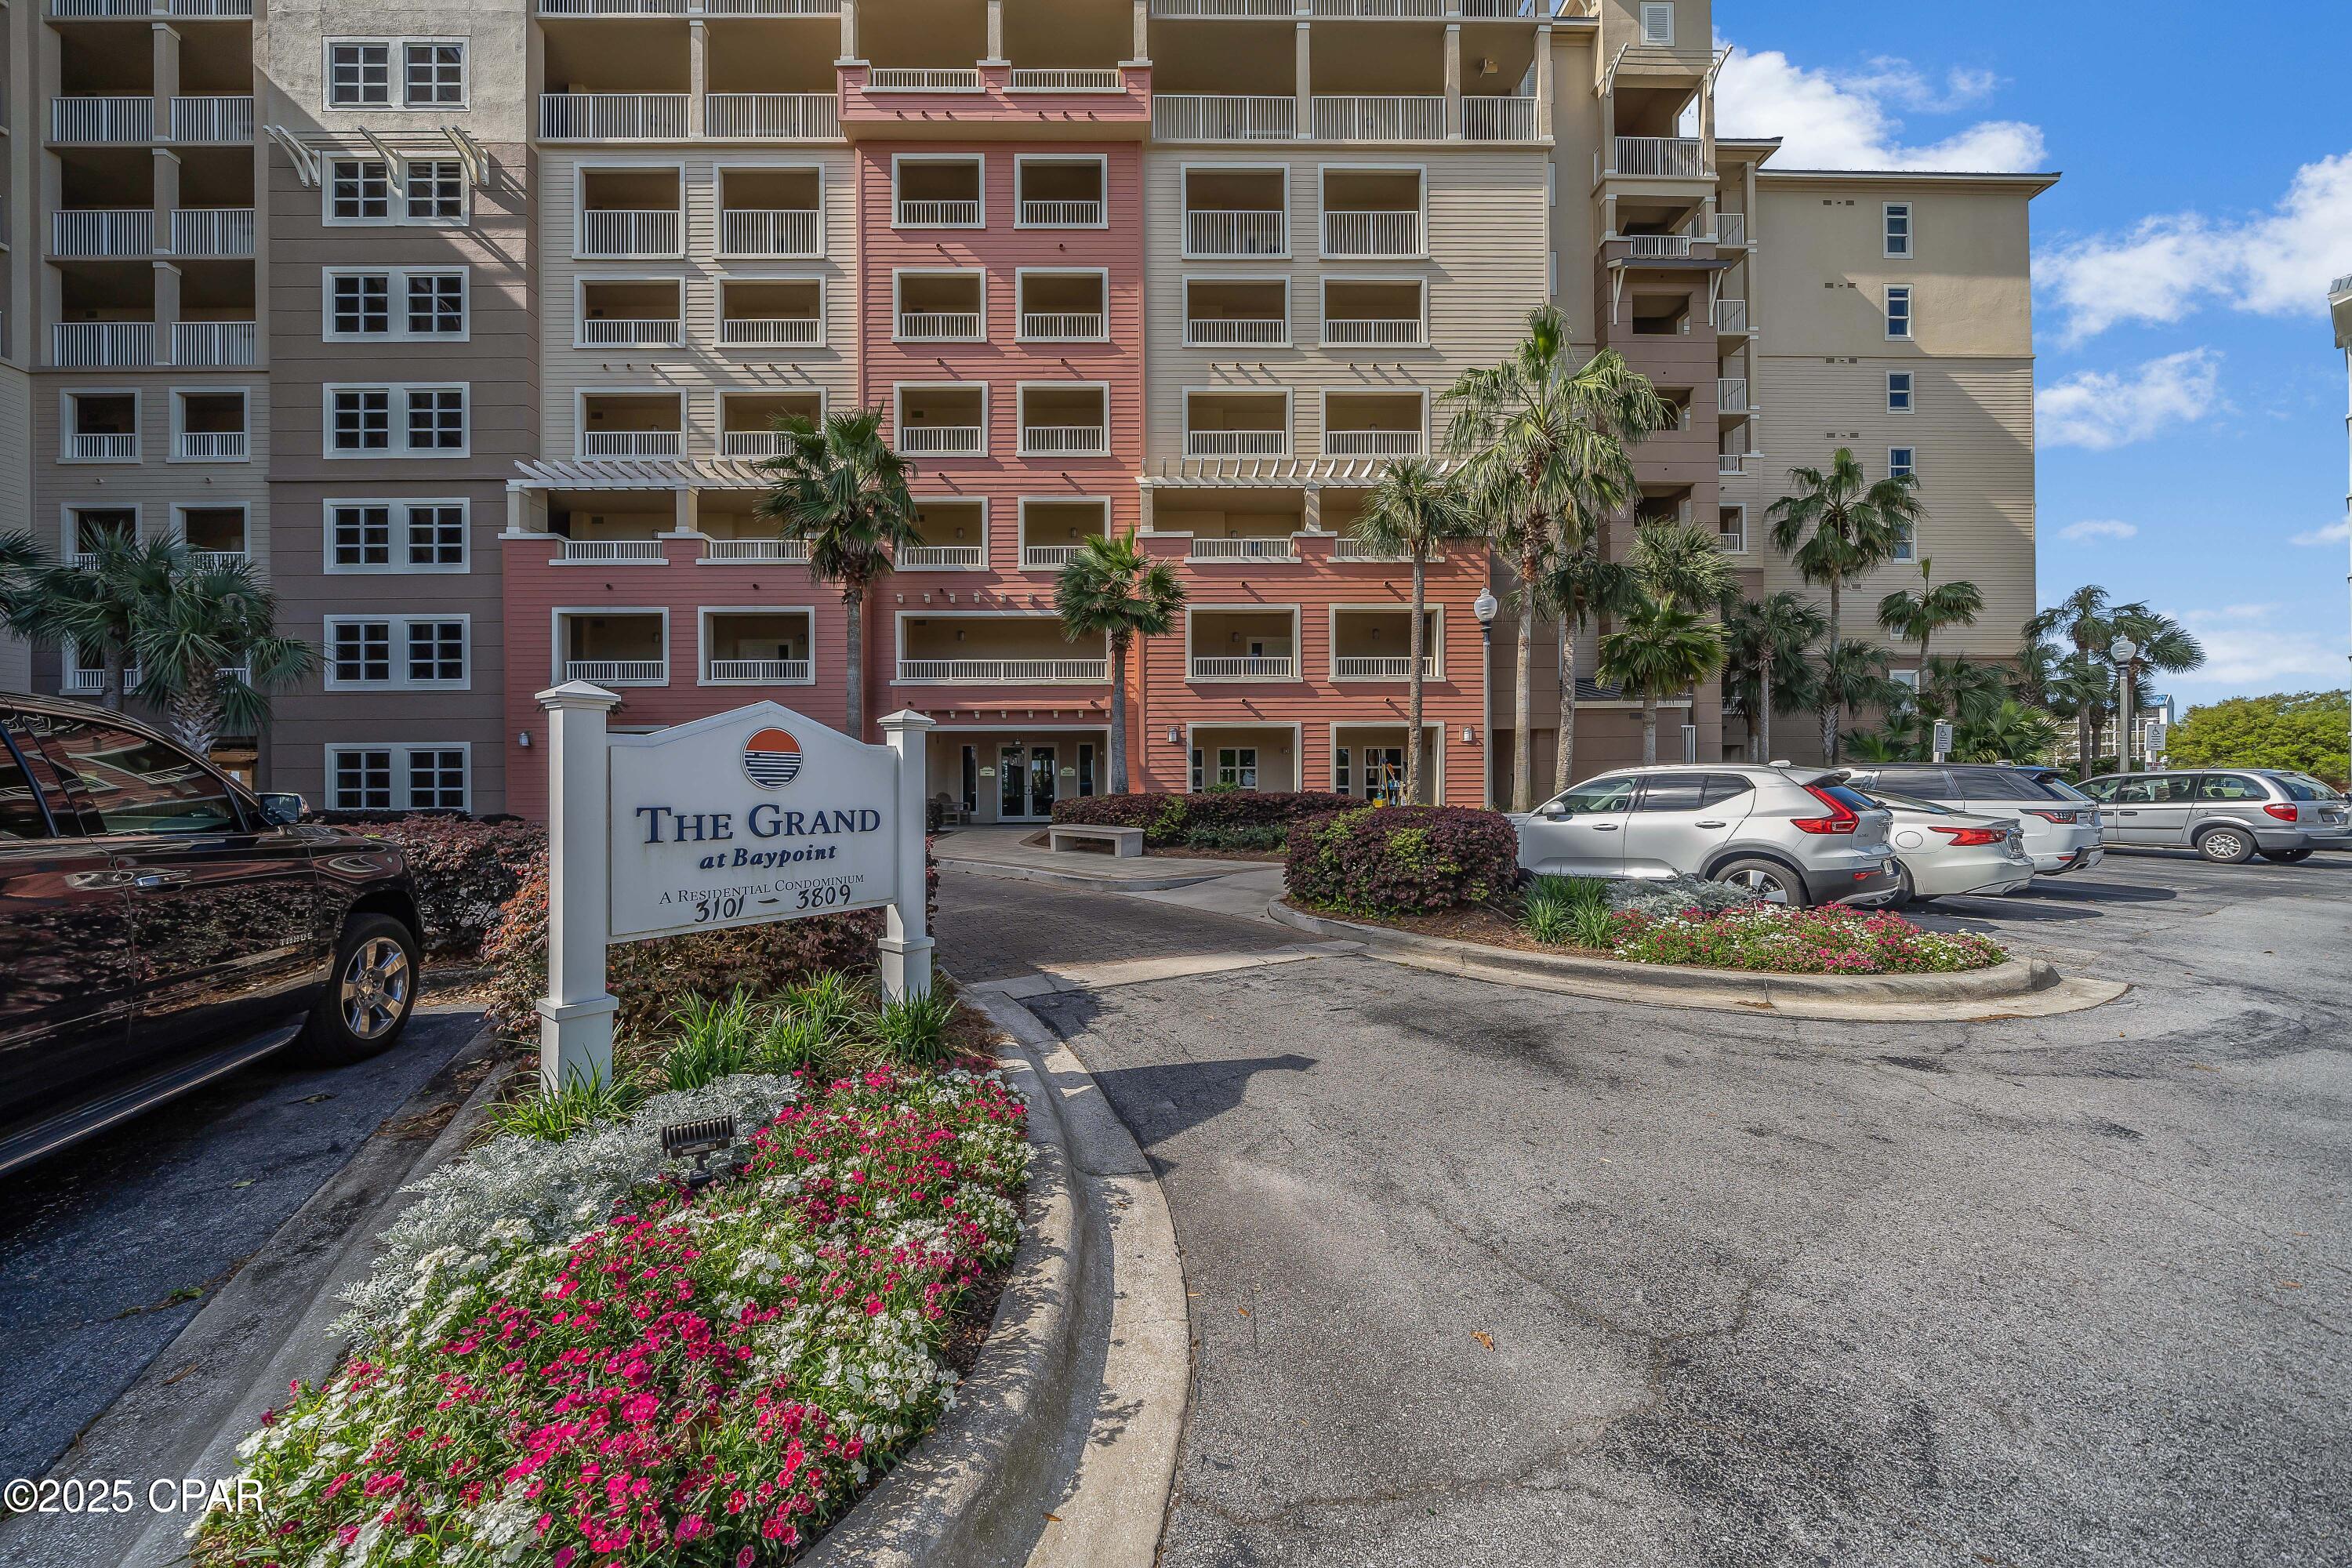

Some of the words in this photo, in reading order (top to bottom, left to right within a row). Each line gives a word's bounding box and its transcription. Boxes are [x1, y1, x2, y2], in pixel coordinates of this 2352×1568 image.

[637, 807, 734, 844] THE
[748, 804, 880, 838] GRAND
[699, 853, 726, 869] at
[731, 844, 837, 868] Baypoint
[659, 891, 672, 904] A
[677, 884, 771, 902] RESIDENTIAL
[775, 874, 864, 891] CONDOMINIUM
[695, 895, 744, 923] 3101
[796, 884, 851, 909] 3809
